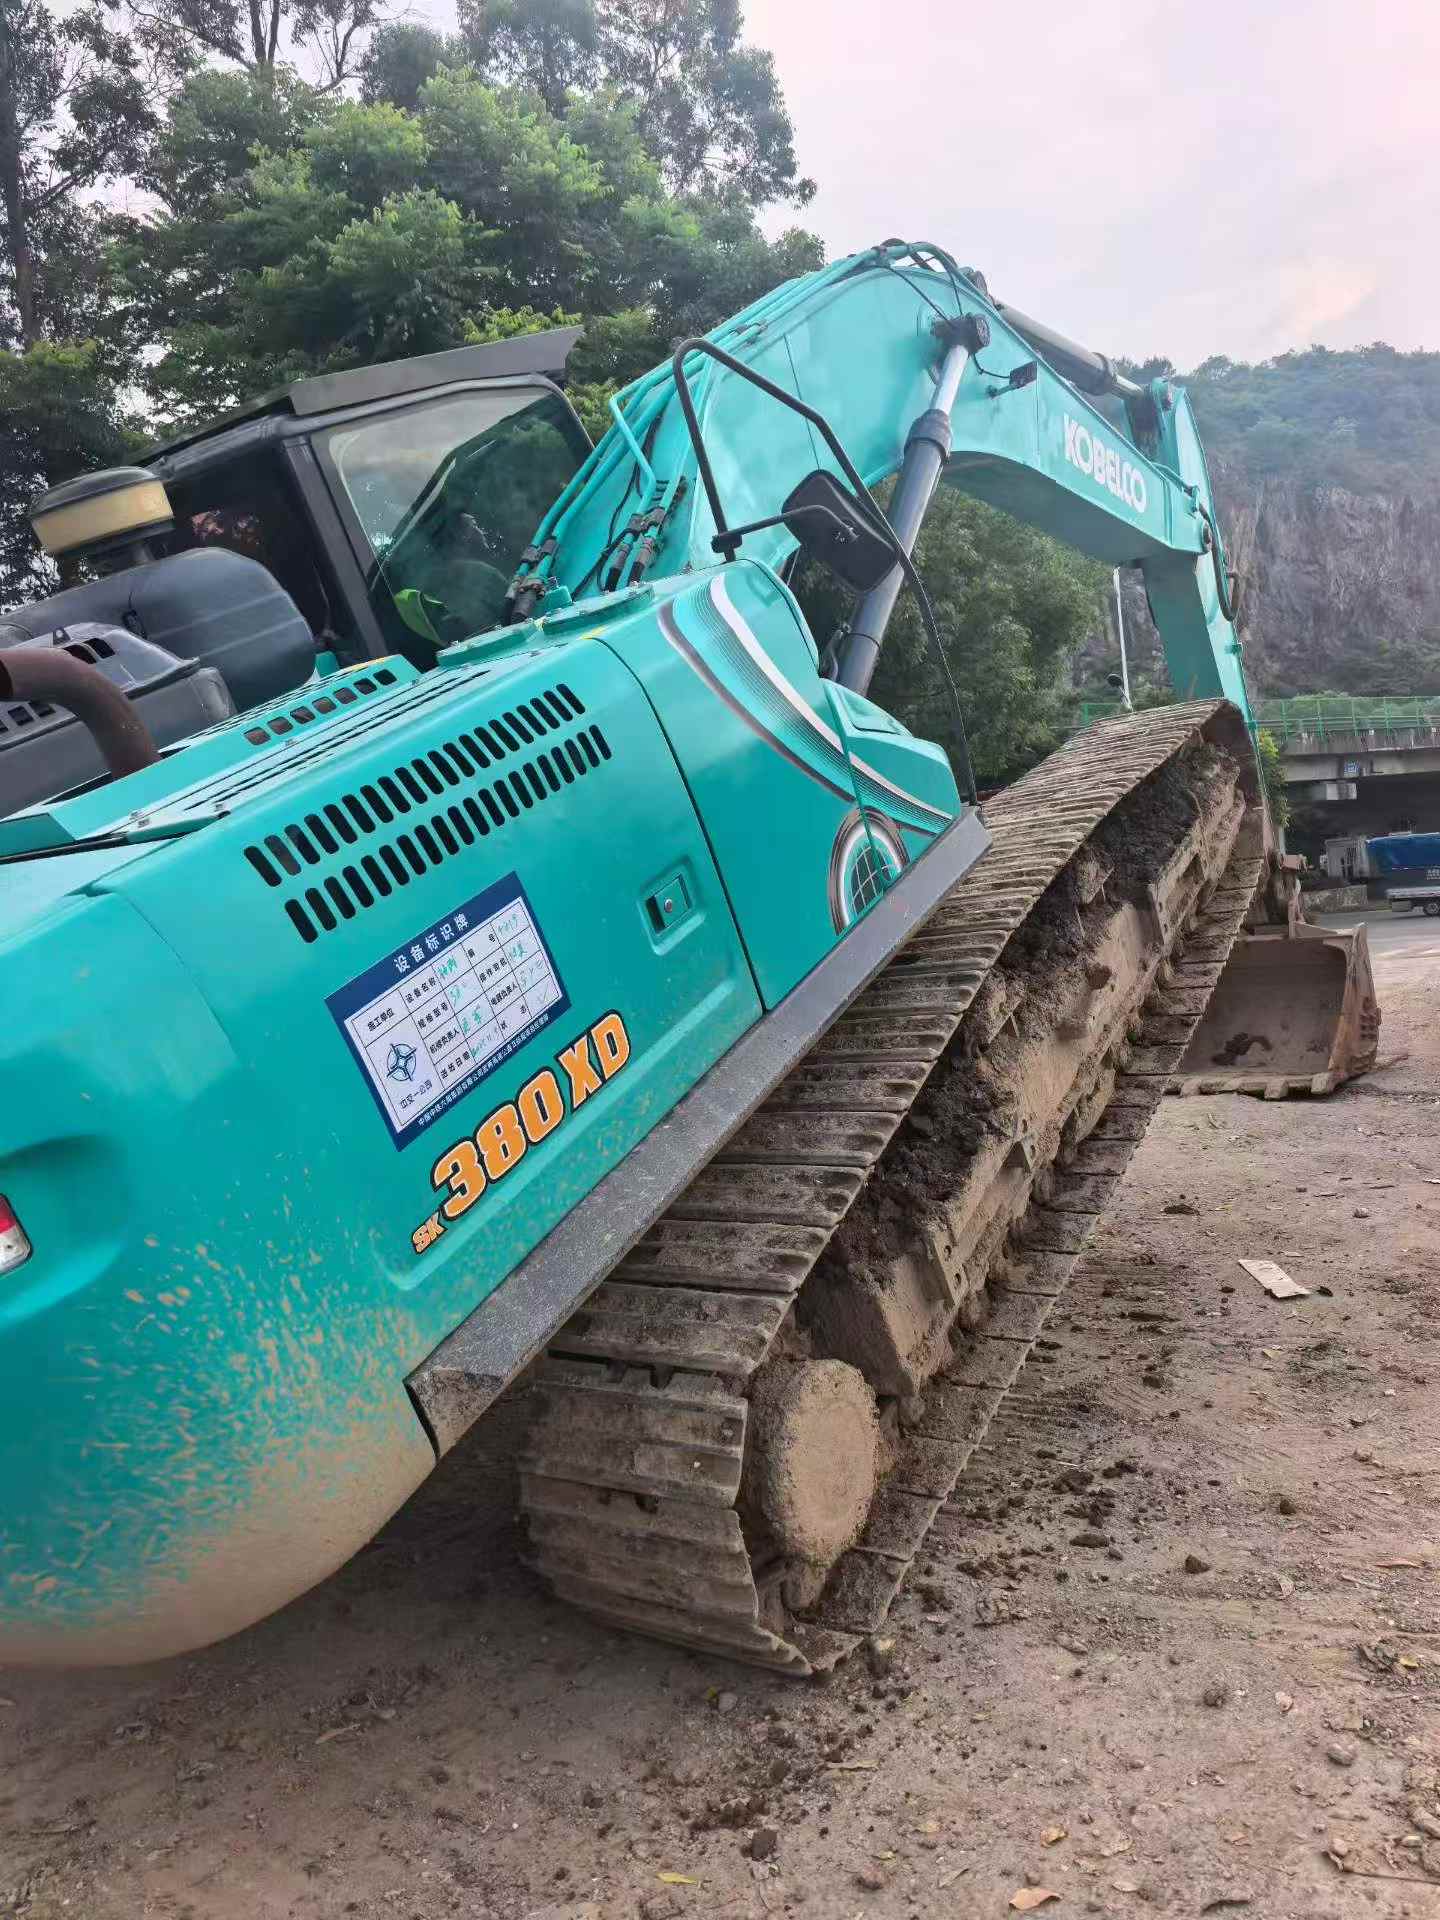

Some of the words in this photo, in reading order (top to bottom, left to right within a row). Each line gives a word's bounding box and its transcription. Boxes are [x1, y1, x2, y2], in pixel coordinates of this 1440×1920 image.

[1063, 412, 1147, 513] KOBELCO
[394, 912, 470, 974] 设备标识牌
